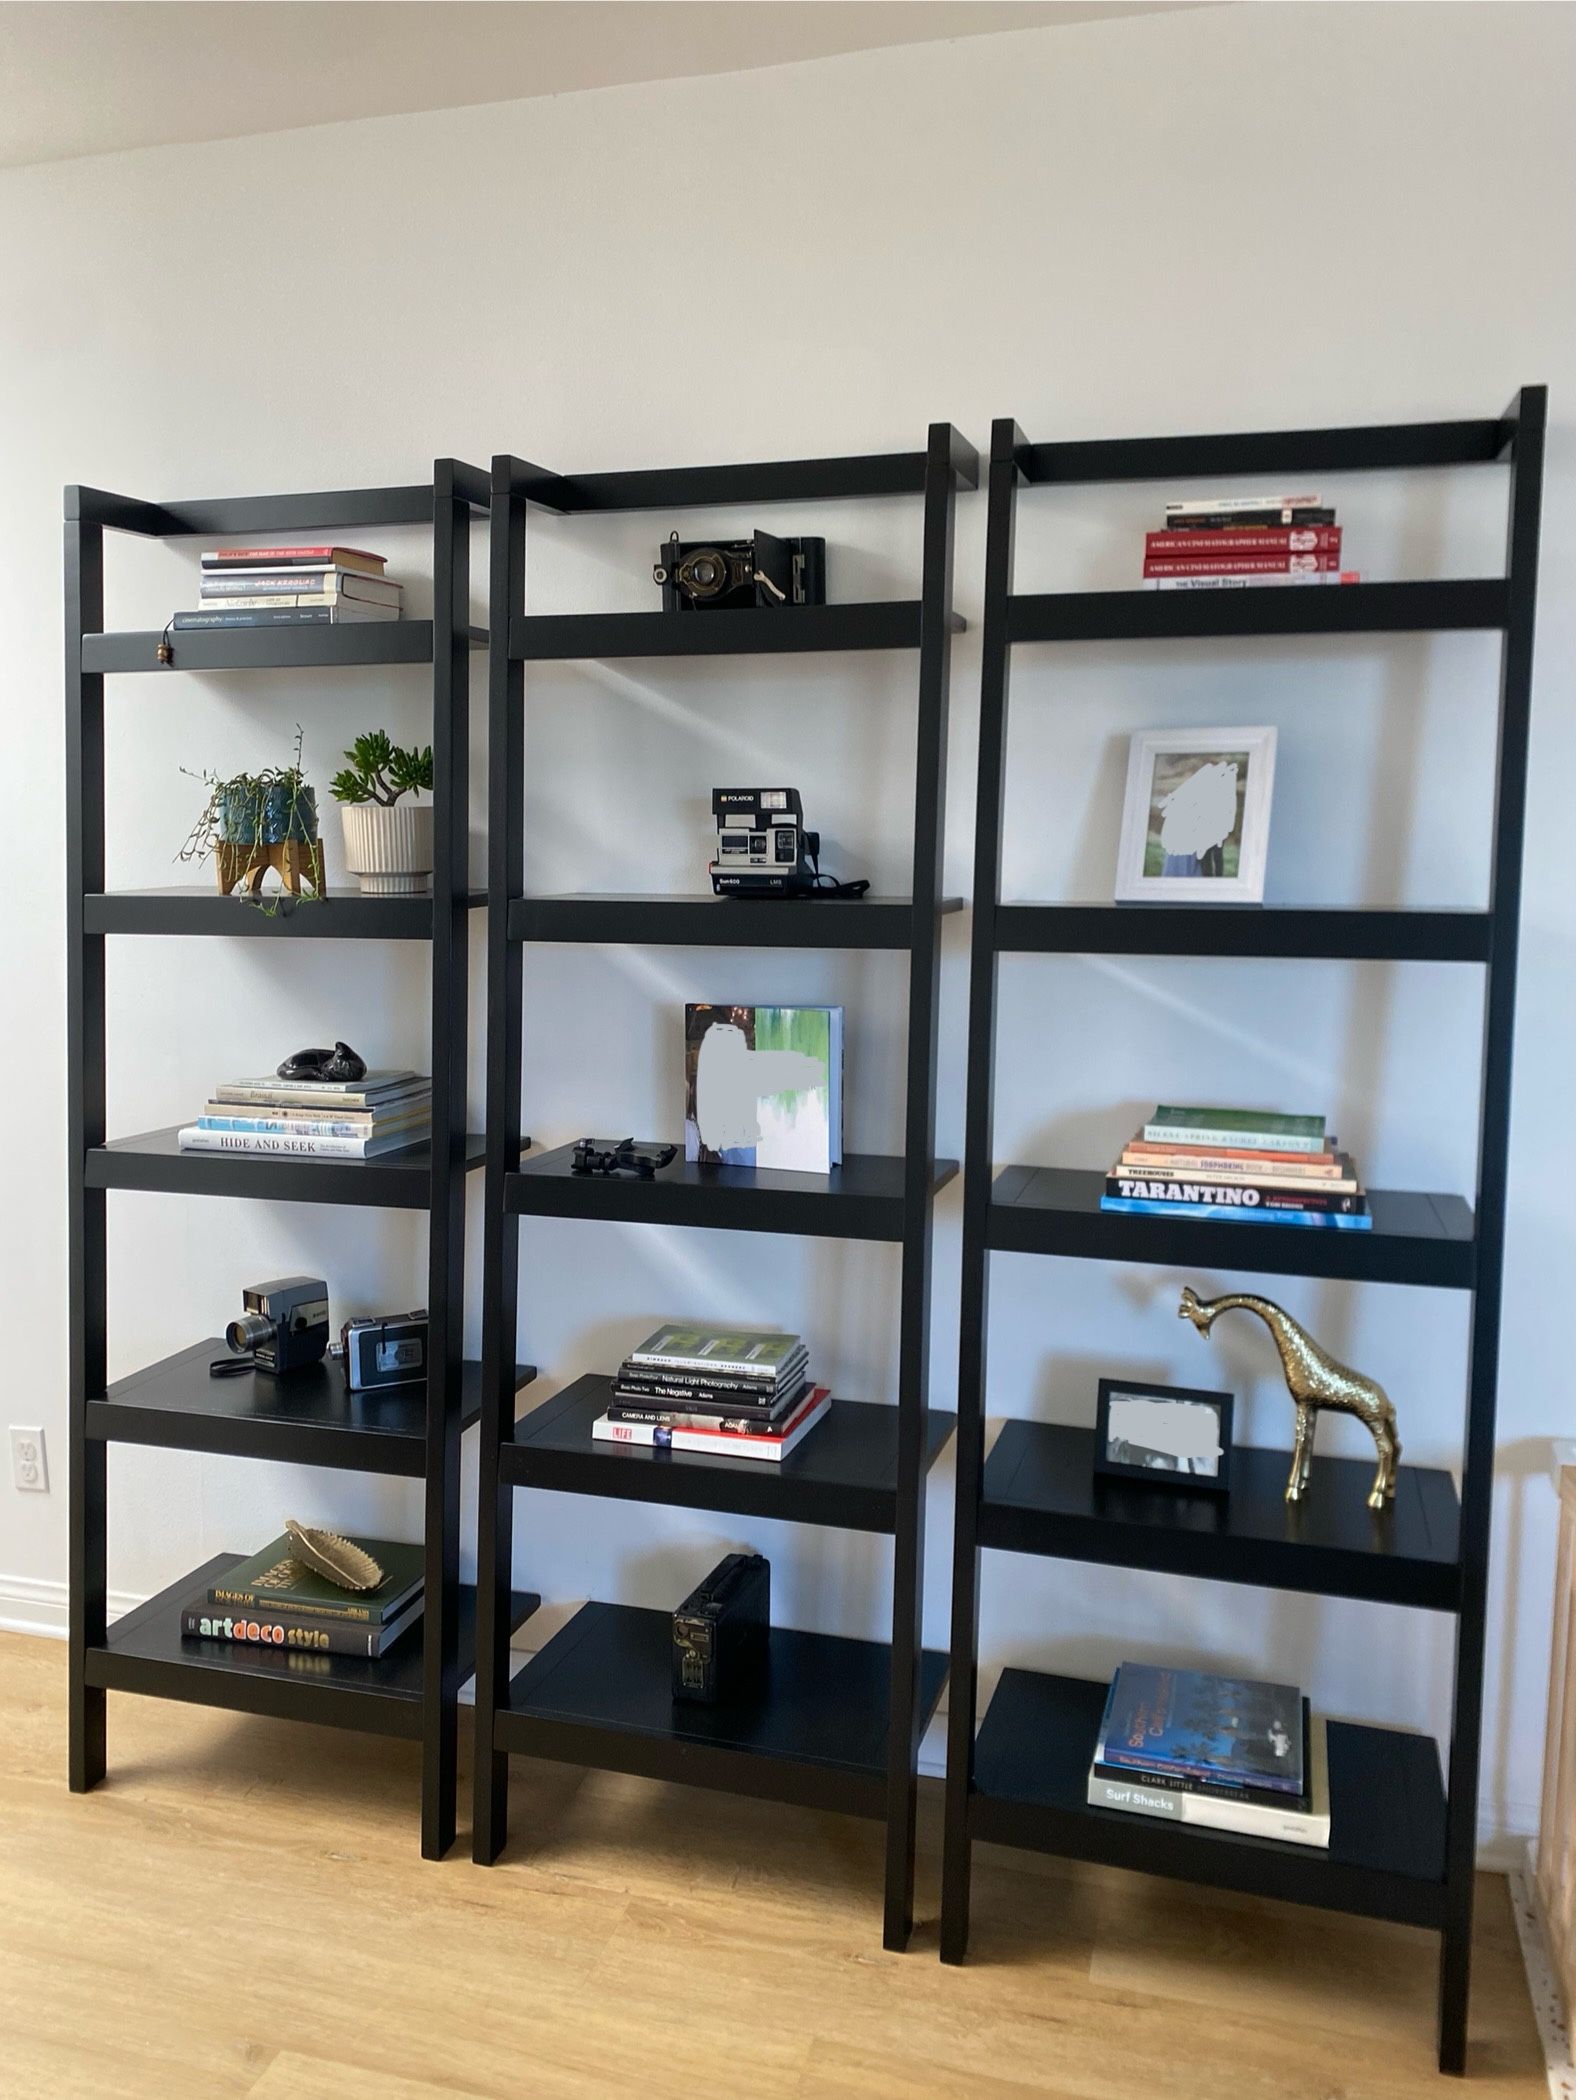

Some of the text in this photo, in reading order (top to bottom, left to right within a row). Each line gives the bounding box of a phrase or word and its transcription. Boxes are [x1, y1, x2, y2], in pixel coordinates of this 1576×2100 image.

[1150, 540, 1186, 549] AMERICAN
[1150, 564, 1186, 572] AMERICAN
[220, 1137, 251, 1149] HIDE
[254, 1140, 280, 1151] AND
[283, 1142, 316, 1153] SEEK
[1118, 1179, 1260, 1207] TARANTINO
[662, 1374, 683, 1385] Natural
[684, 1376, 700, 1388] Light
[700, 1378, 738, 1390] Photography
[655, 1386, 666, 1396] The
[666, 1388, 693, 1398] Negative
[622, 1412, 644, 1420] CAMERA
[614, 1428, 631, 1439] LIFE
[287, 1628, 330, 1648] style
[1140, 1775, 1167, 1786] CLARK
[1169, 1780, 1193, 1791] LITTLE
[1106, 1788, 1174, 1812] Surf Shacks
